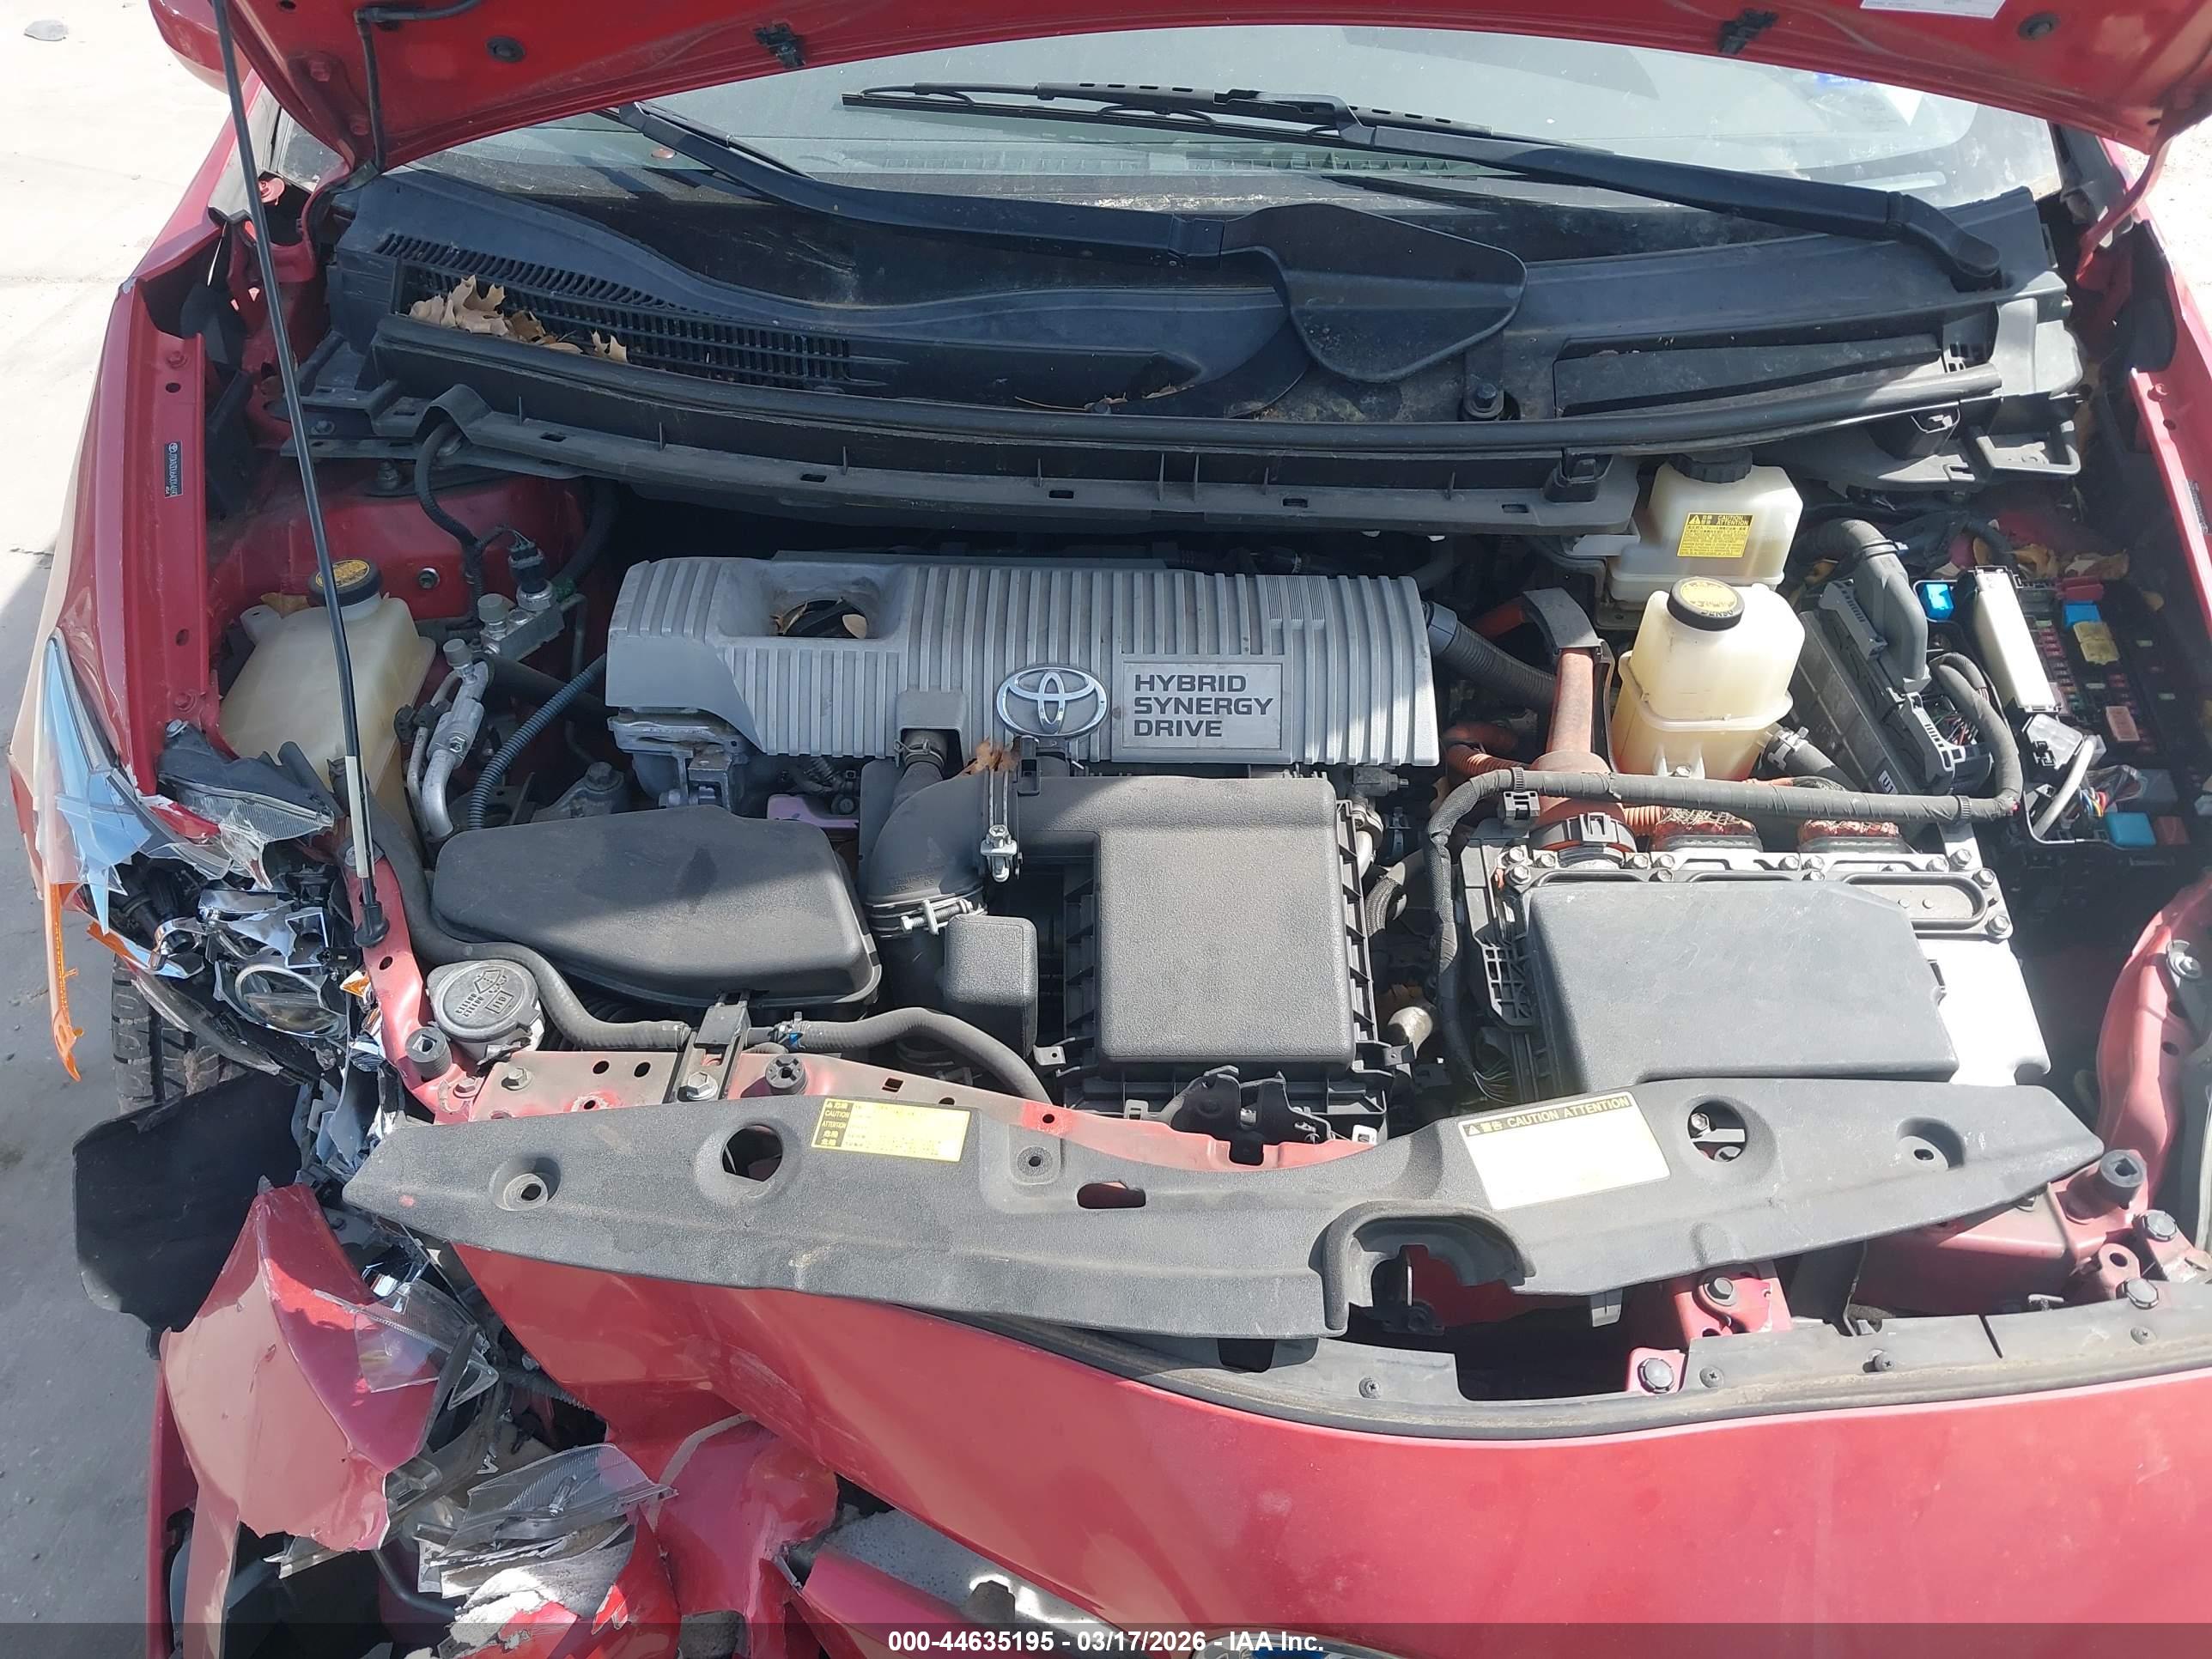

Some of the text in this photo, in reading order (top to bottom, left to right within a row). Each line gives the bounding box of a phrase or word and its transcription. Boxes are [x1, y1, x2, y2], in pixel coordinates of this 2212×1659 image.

[1134, 674, 1247, 692] HYBRID
[1133, 696, 1273, 715] SYNERGY
[1133, 719, 1223, 738] DRIVE
[824, 1109, 850, 1118] CAUTION
[1507, 1111, 1559, 1128] CAUTION
[1564, 1097, 1630, 1118] ATTENTION
